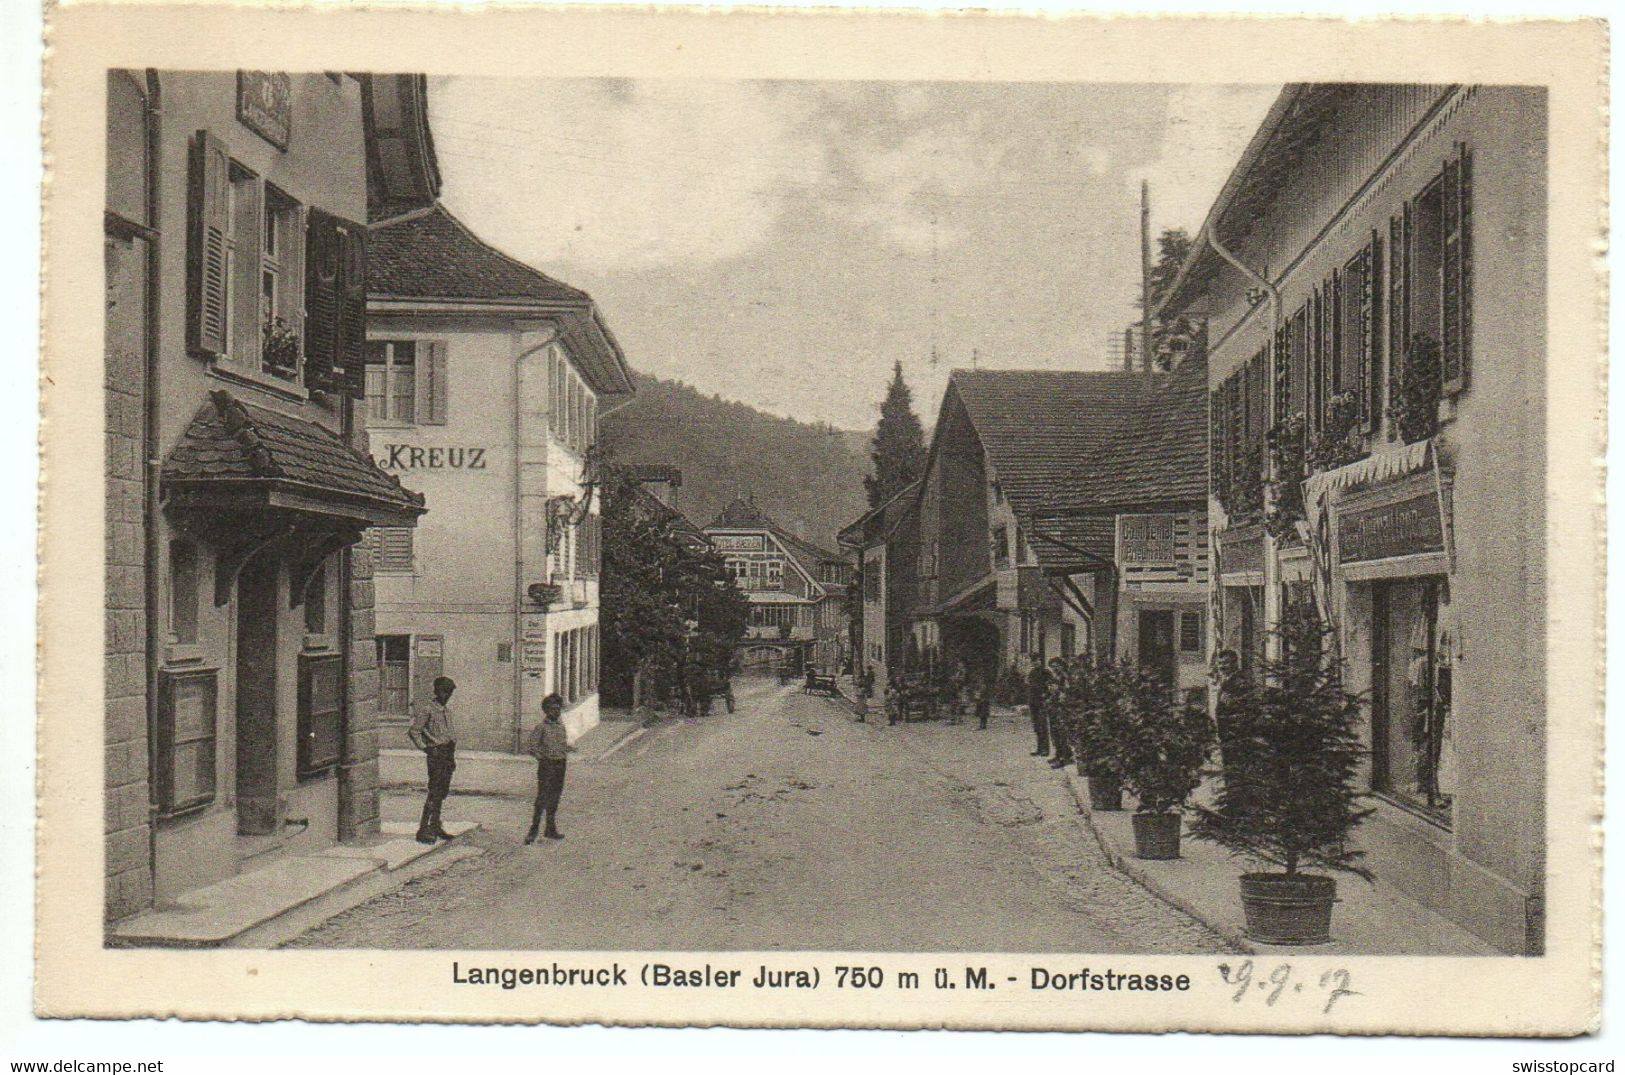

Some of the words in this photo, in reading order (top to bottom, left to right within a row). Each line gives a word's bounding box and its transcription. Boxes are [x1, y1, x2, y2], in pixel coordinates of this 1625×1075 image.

[378, 443, 487, 472] KREUZ
[453, 961, 627, 990] Langenbruck
[640, 963, 742, 988] (Basler
[752, 965, 821, 989] Jura)
[835, 966, 884, 989] 750
[898, 971, 919, 989] m
[934, 967, 956, 990] ü.
[965, 967, 996, 990] M.
[1031, 967, 1191, 992] Dorfstrasse
